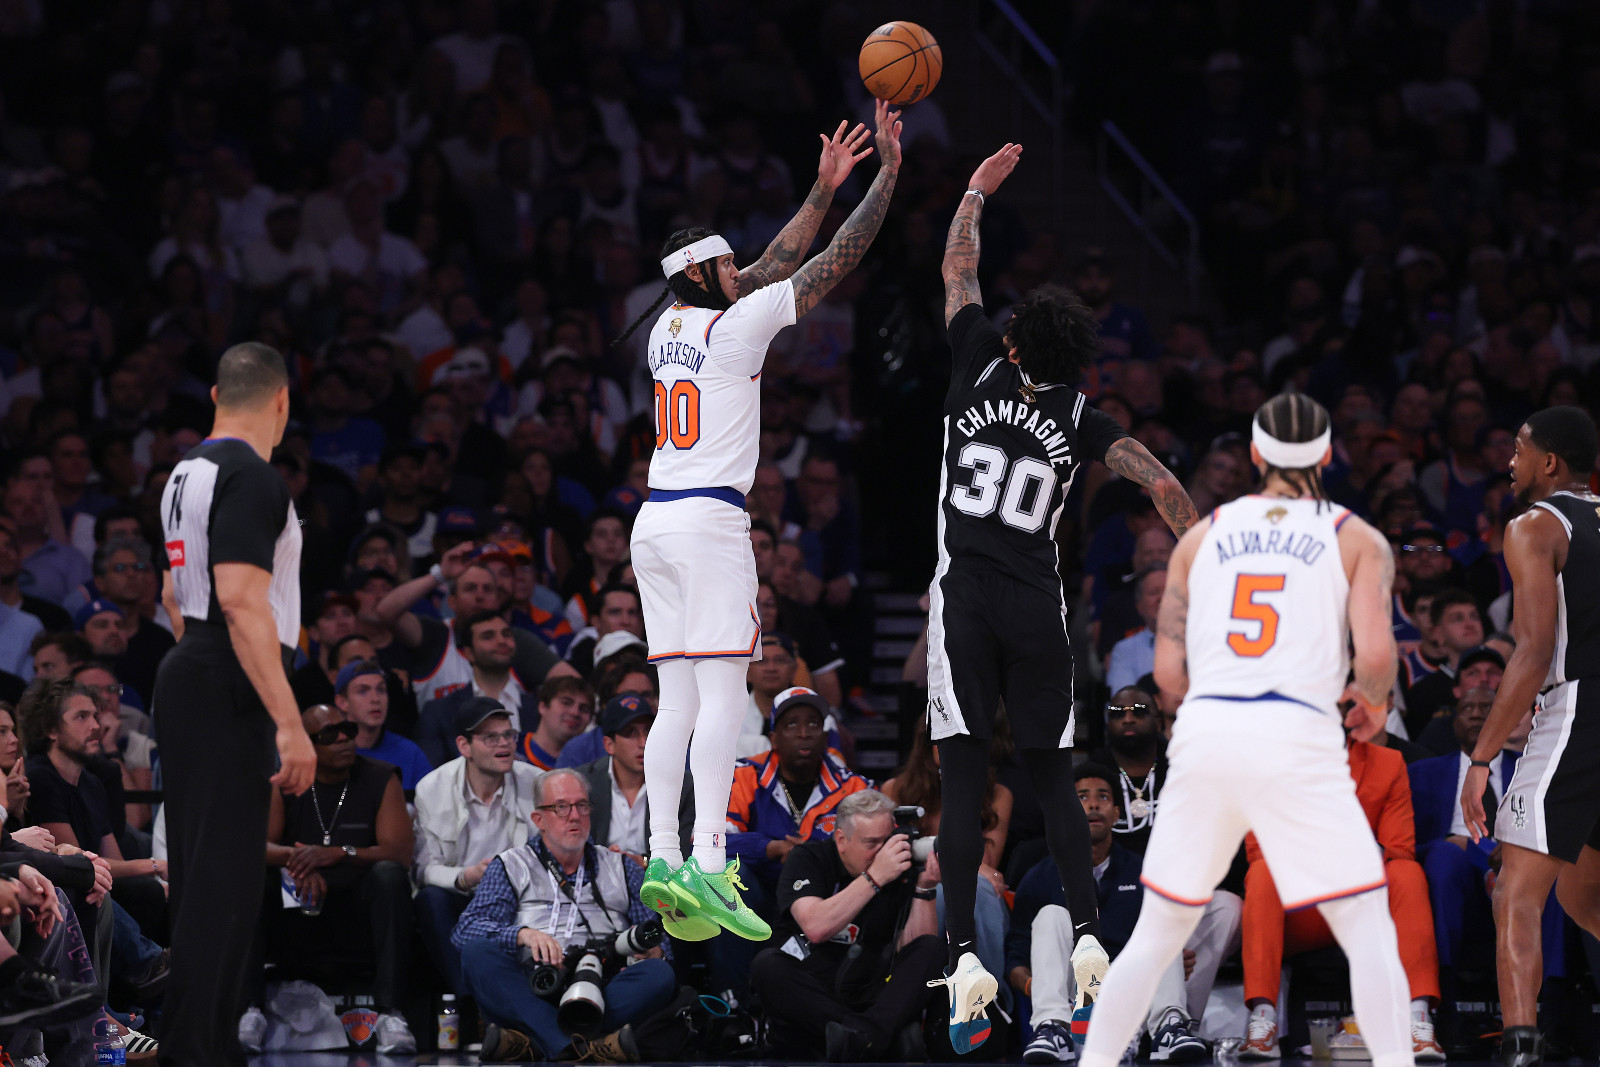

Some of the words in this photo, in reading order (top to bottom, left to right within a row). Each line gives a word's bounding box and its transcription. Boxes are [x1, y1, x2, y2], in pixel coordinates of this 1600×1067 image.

[956, 399, 1072, 469] CHAMPAGNIE
[950, 441, 1058, 534] 30
[1216, 530, 1325, 566] ALVARADO
[1226, 572, 1286, 658] 5
